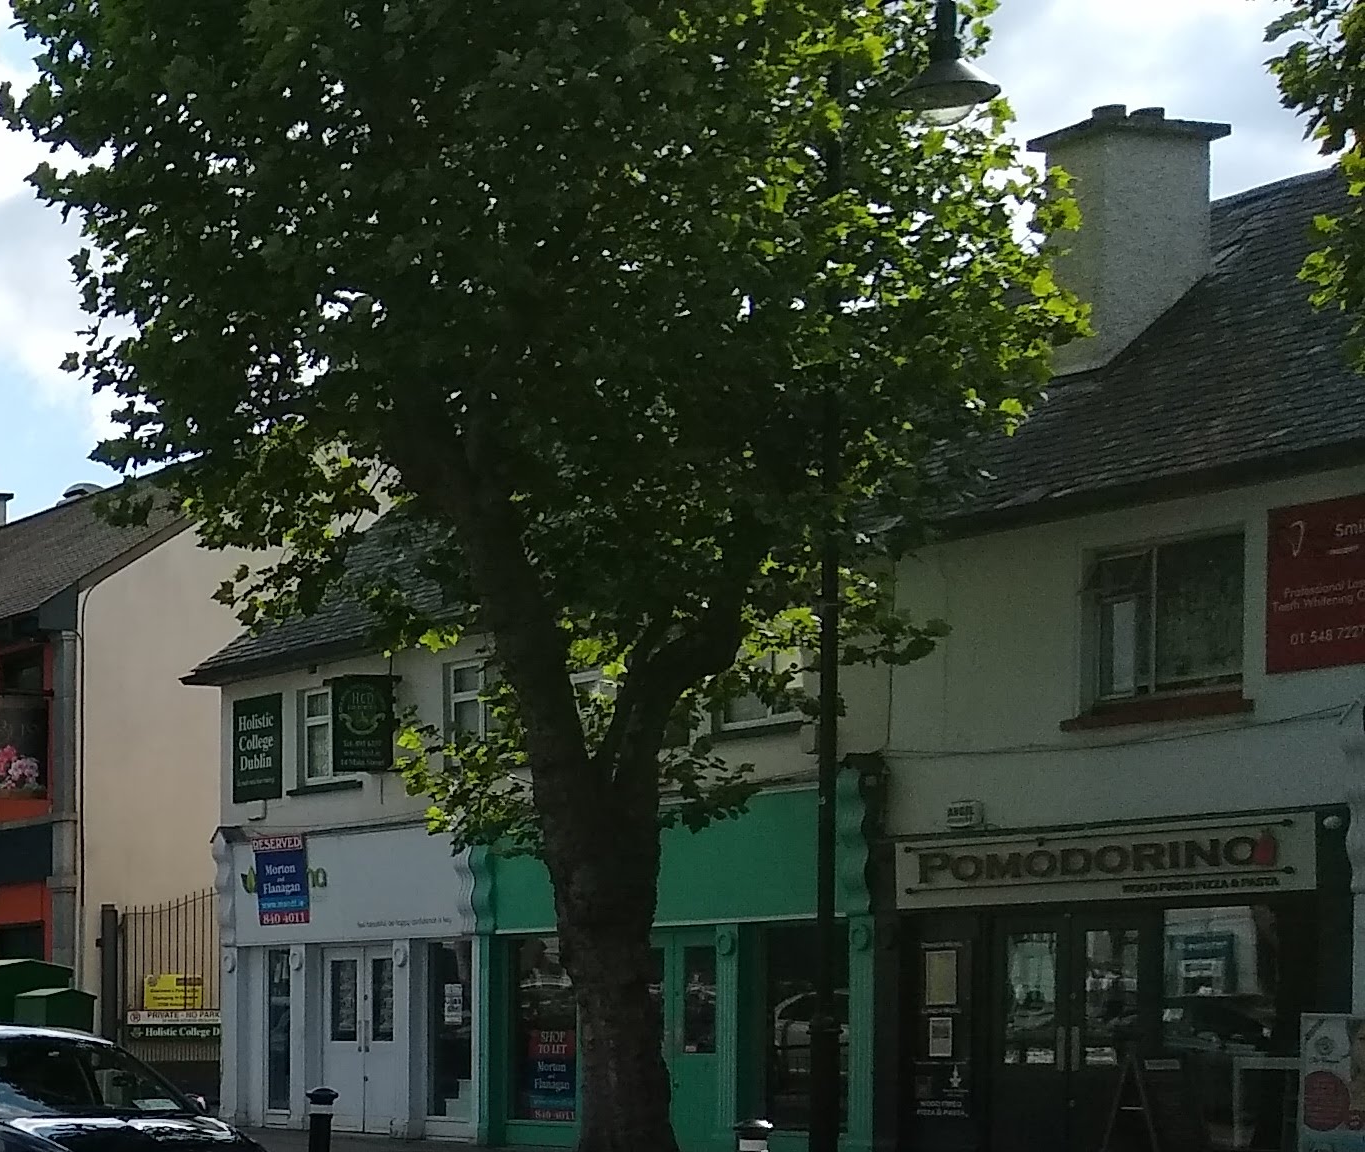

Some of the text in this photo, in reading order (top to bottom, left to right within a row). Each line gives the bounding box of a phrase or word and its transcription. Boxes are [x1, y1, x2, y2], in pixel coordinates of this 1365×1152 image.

[1284, 580, 1345, 598] Professional
[1271, 601, 1300, 613] Teeth
[1303, 593, 1354, 607] Whitening
[1290, 632, 1304, 645] 01
[238, 711, 274, 732] Holistic
[238, 734, 274, 752] College
[239, 752, 272, 771] Dublin
[253, 837, 301, 850] RESERVED
[918, 835, 1257, 884] POMODORINO
[265, 865, 296, 876] Morton
[263, 882, 301, 895] Flanagan
[1195, 879, 1229, 889] PIZZA
[1241, 876, 1279, 887] PASTA
[263, 912, 305, 924] 840 4011
[145, 1027, 178, 1037] Holistic
[178, 1027, 211, 1038] College
[540, 1030, 566, 1043] SHOP
[537, 1044, 568, 1054] TO LET
[537, 1061, 566, 1072] Morton
[534, 1077, 570, 1092] Flanagan
